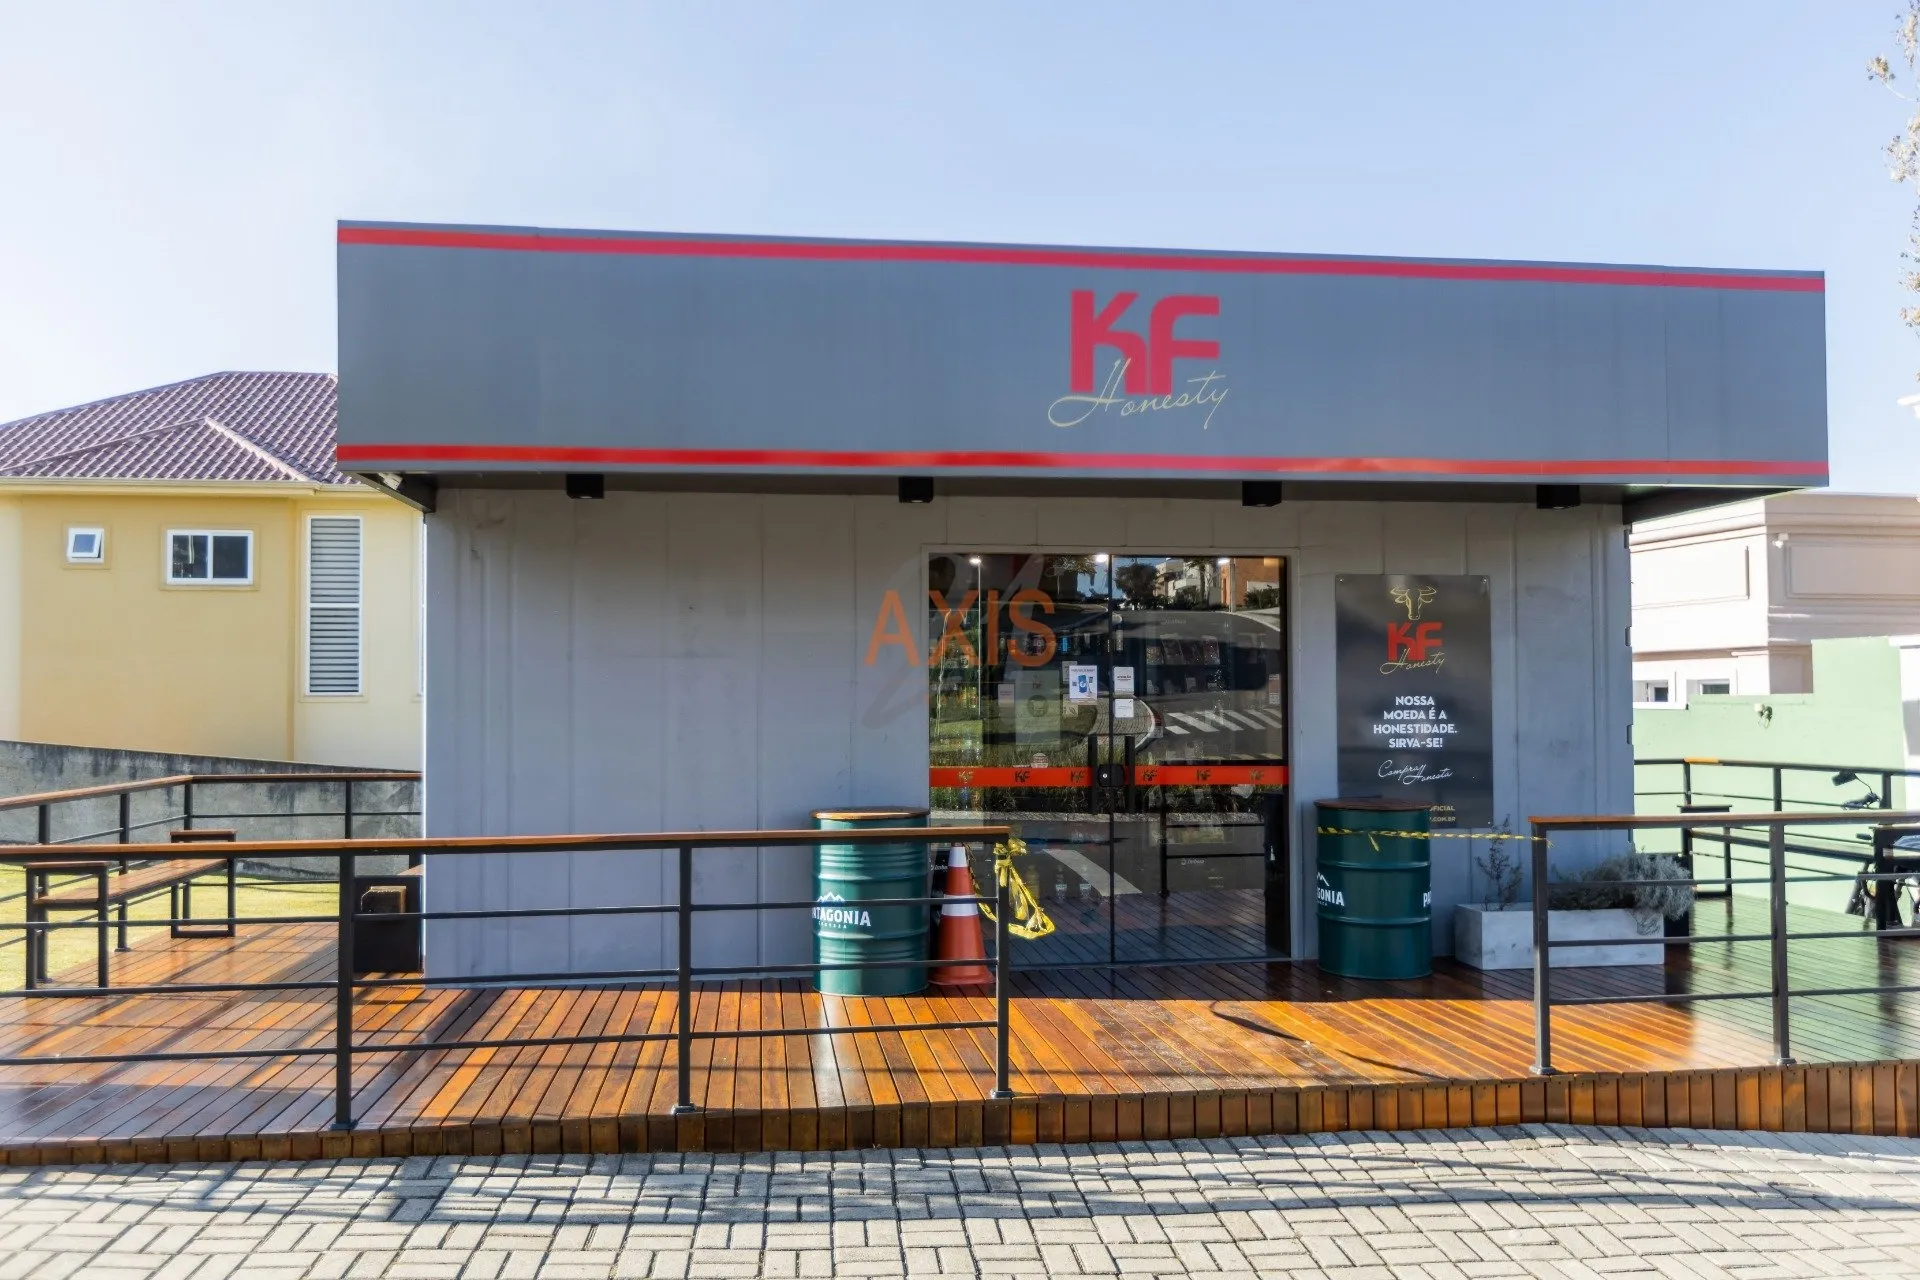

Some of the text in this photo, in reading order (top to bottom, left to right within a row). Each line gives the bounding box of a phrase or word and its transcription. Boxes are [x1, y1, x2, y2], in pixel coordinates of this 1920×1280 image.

[1071, 290, 1220, 395] KF
[1048, 358, 1231, 430] Honesty
[1387, 621, 1443, 661] KF
[1379, 648, 1446, 675] Honesty
[1395, 695, 1435, 706] NOSSA
[1383, 706, 1447, 720] MOEDA É A
[1373, 723, 1458, 734] HONESTIDADE.
[1389, 737, 1443, 748] SIRVA-SE!
